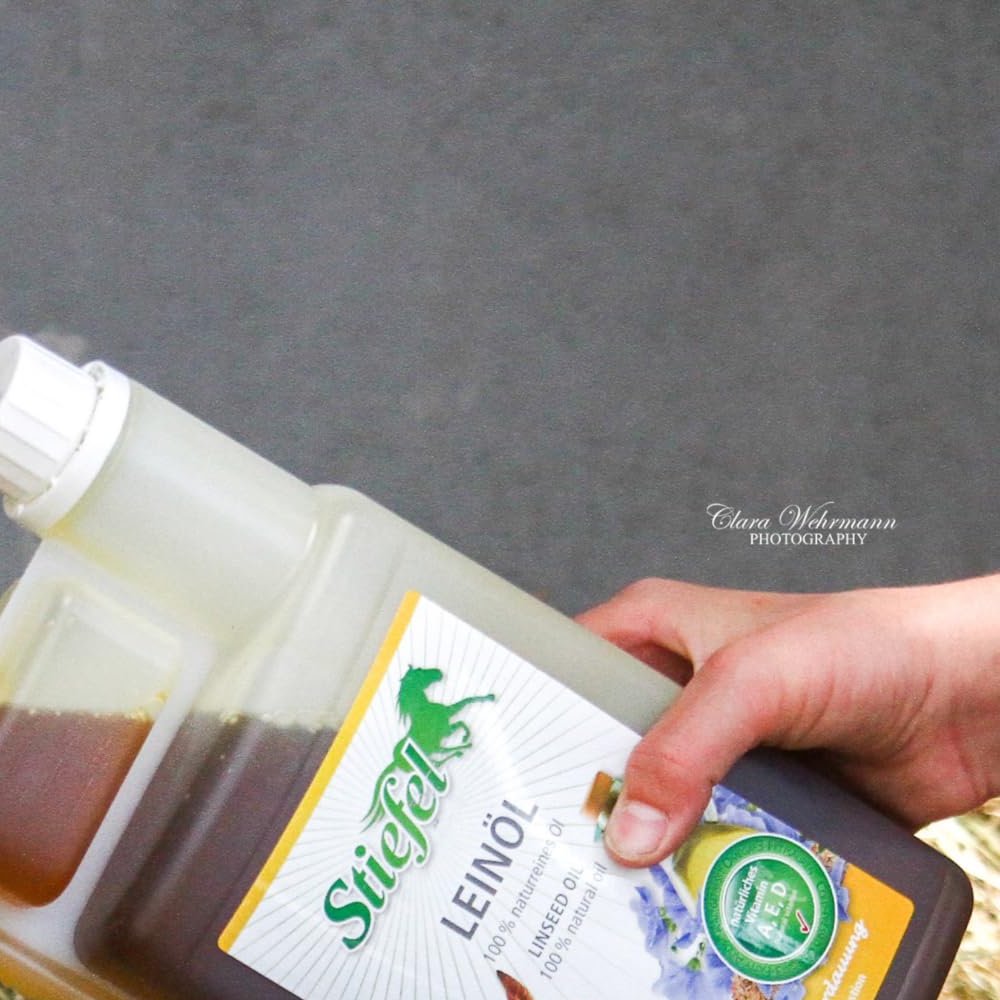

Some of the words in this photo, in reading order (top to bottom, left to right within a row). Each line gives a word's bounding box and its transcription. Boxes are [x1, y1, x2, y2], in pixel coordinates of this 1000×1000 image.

[323, 741, 448, 950] Stiefel
[440, 799, 539, 941] LEINÖL
[771, 881, 787, 898] D
[483, 935, 506, 963] 100
[501, 920, 516, 935] %
[511, 838, 557, 918] naturreines
[528, 893, 569, 958] LINSEED
[563, 866, 584, 891] OIL
[540, 952, 563, 980] 100
[557, 937, 572, 952] %
[567, 882, 598, 936] natural
[594, 861, 608, 883] oil
[744, 879, 769, 924] Vitamin
[757, 921, 778, 939] A,
[765, 901, 785, 917] E,
